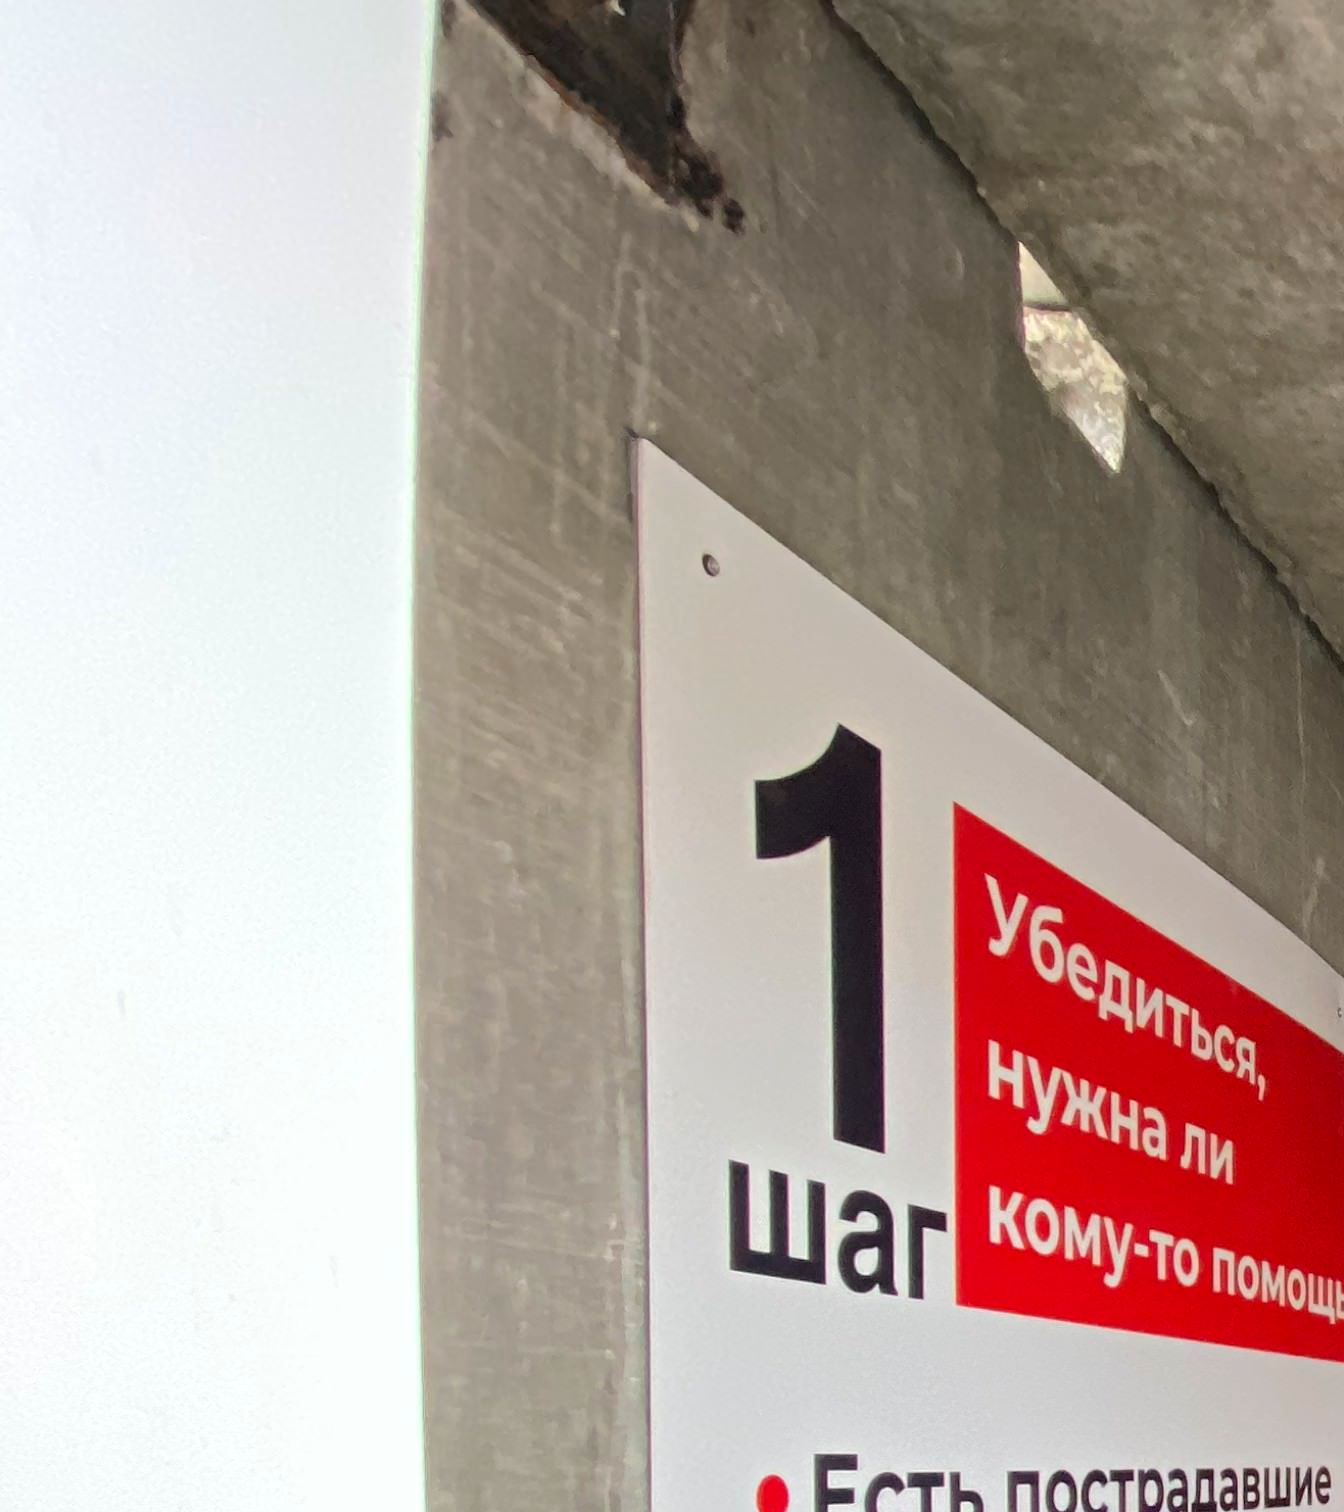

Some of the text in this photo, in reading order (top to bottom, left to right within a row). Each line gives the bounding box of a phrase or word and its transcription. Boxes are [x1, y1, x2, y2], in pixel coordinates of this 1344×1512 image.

[754, 723, 885, 1154] 1
[984, 872, 1267, 1100] Убедиться,
[987, 1040, 1235, 1185] нужна ли
[728, 1159, 947, 1300] шаг
[989, 1184, 1200, 1288] кому-то
